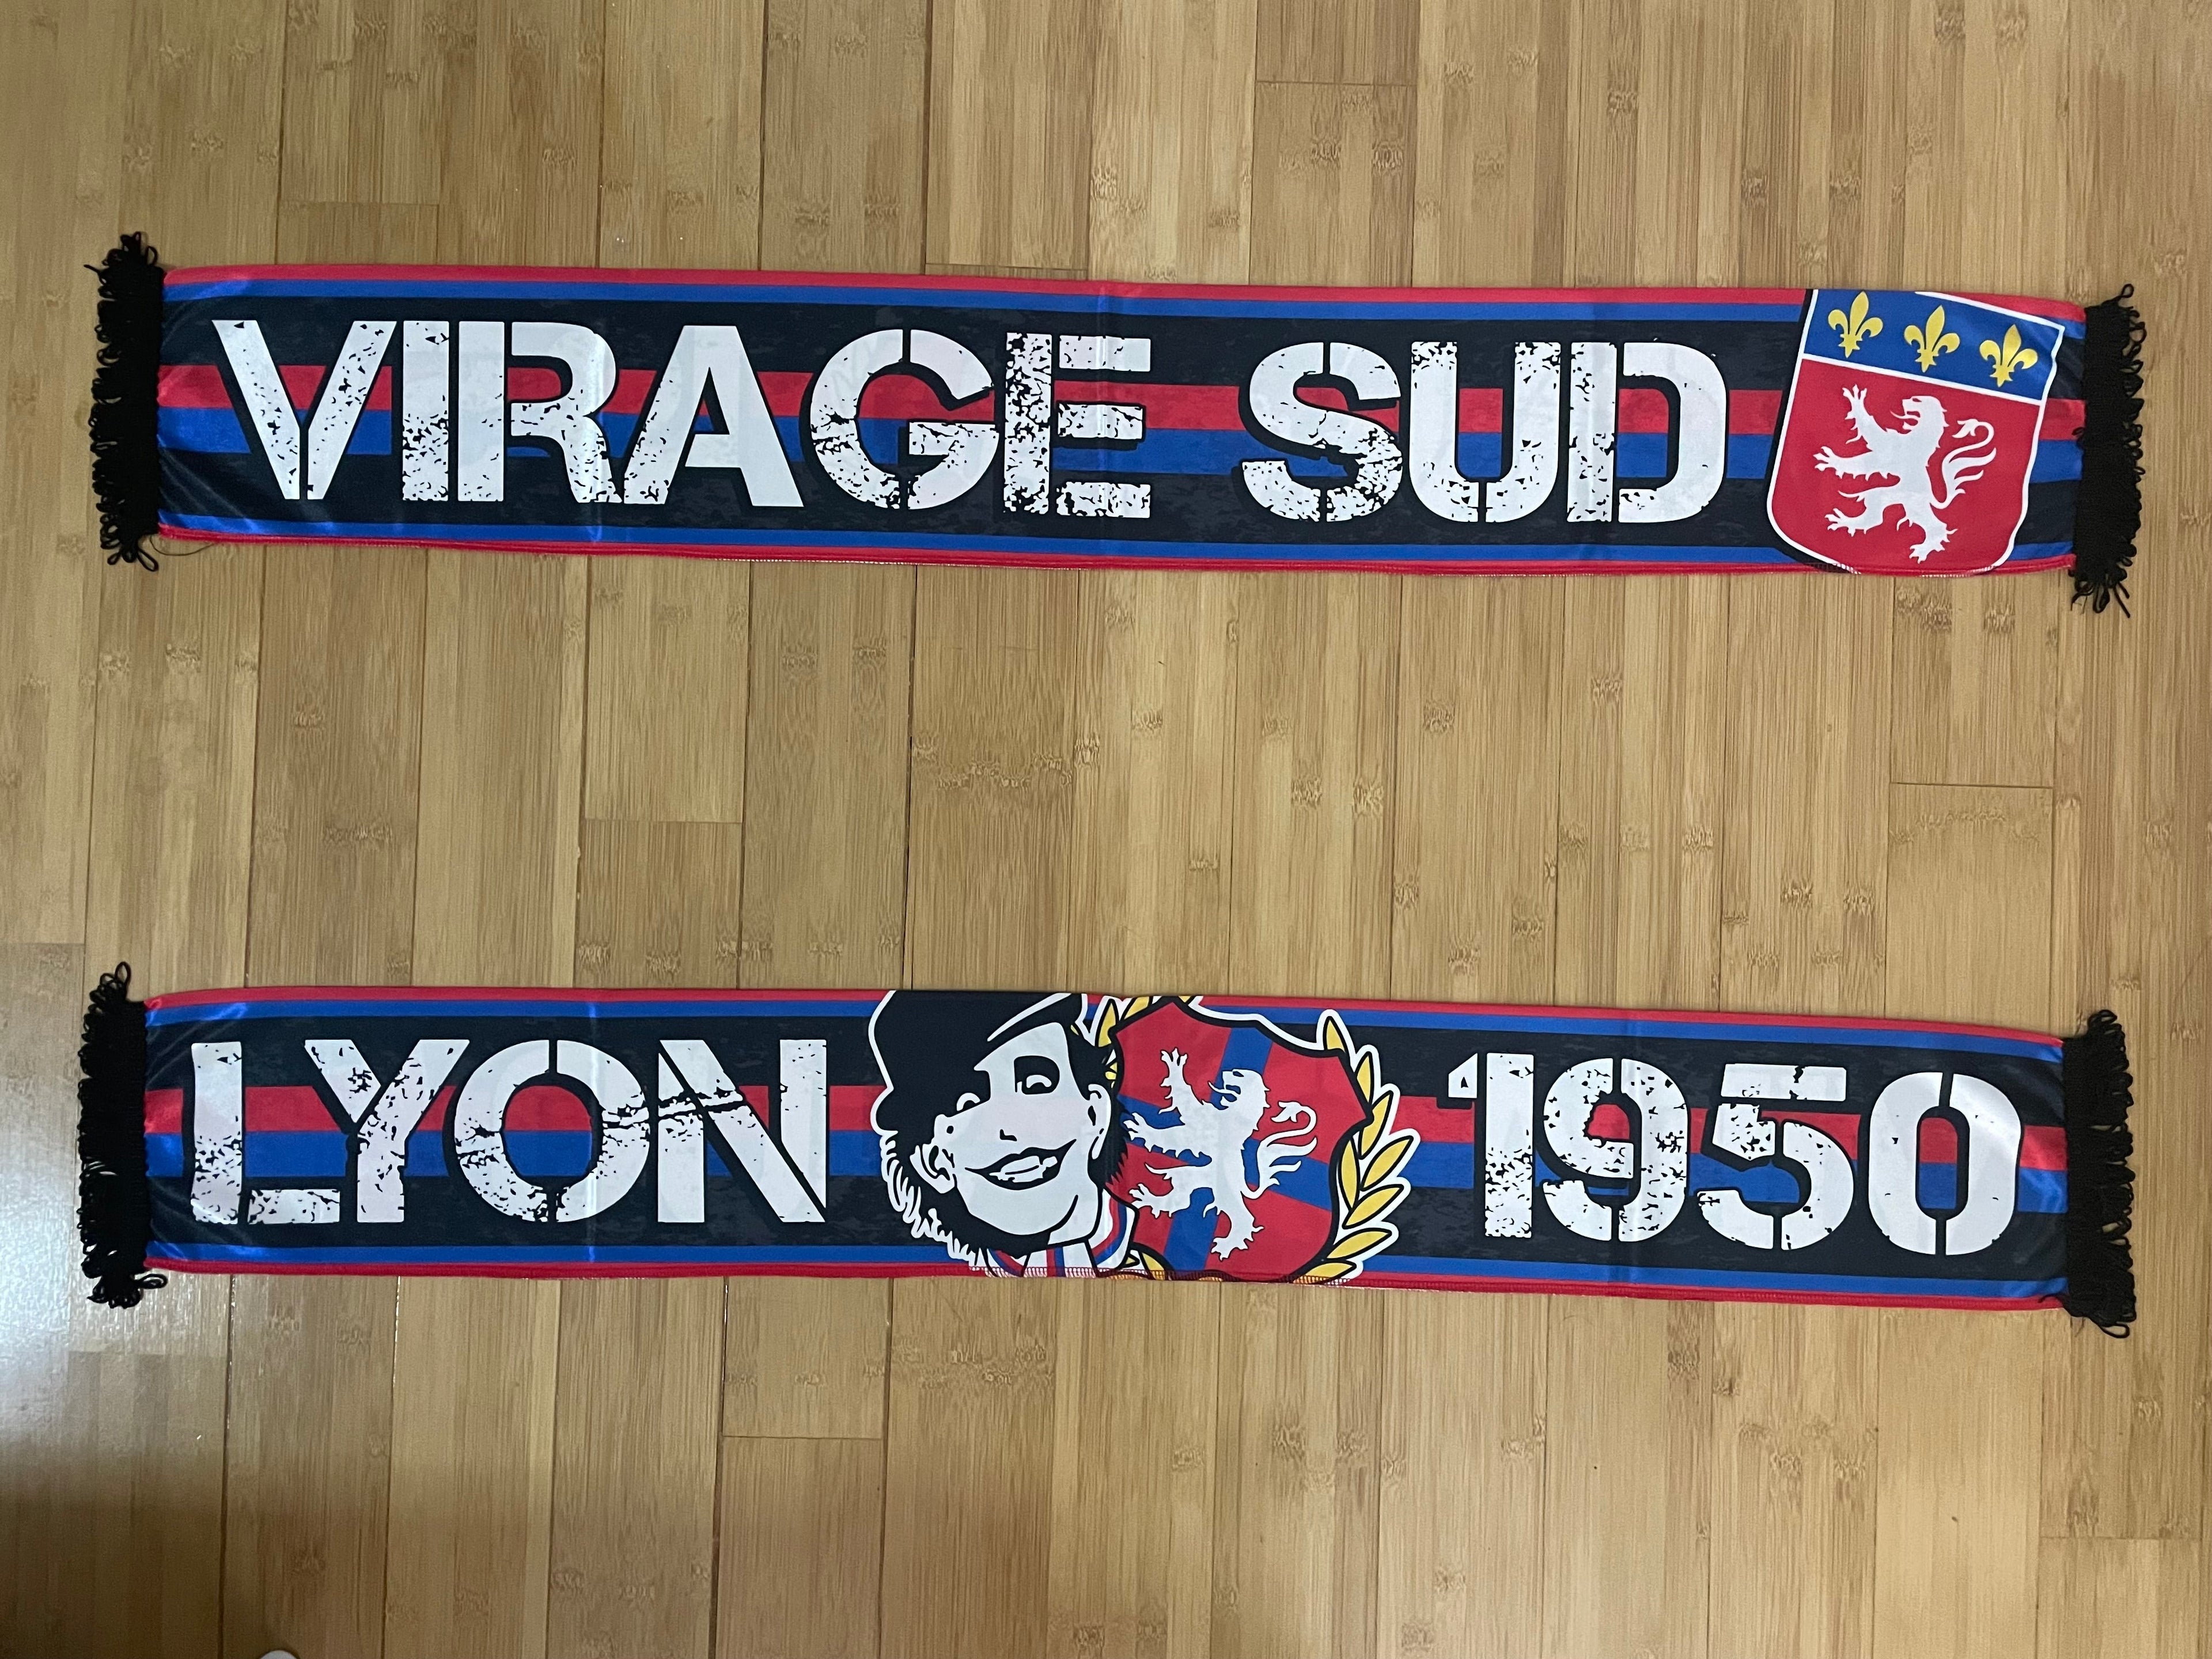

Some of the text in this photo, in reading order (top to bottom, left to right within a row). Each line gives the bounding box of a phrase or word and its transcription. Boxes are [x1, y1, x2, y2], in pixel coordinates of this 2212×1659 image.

[211, 319, 1727, 523] VIRAGE SUD
[190, 1039, 2022, 1256] LYON 1950
